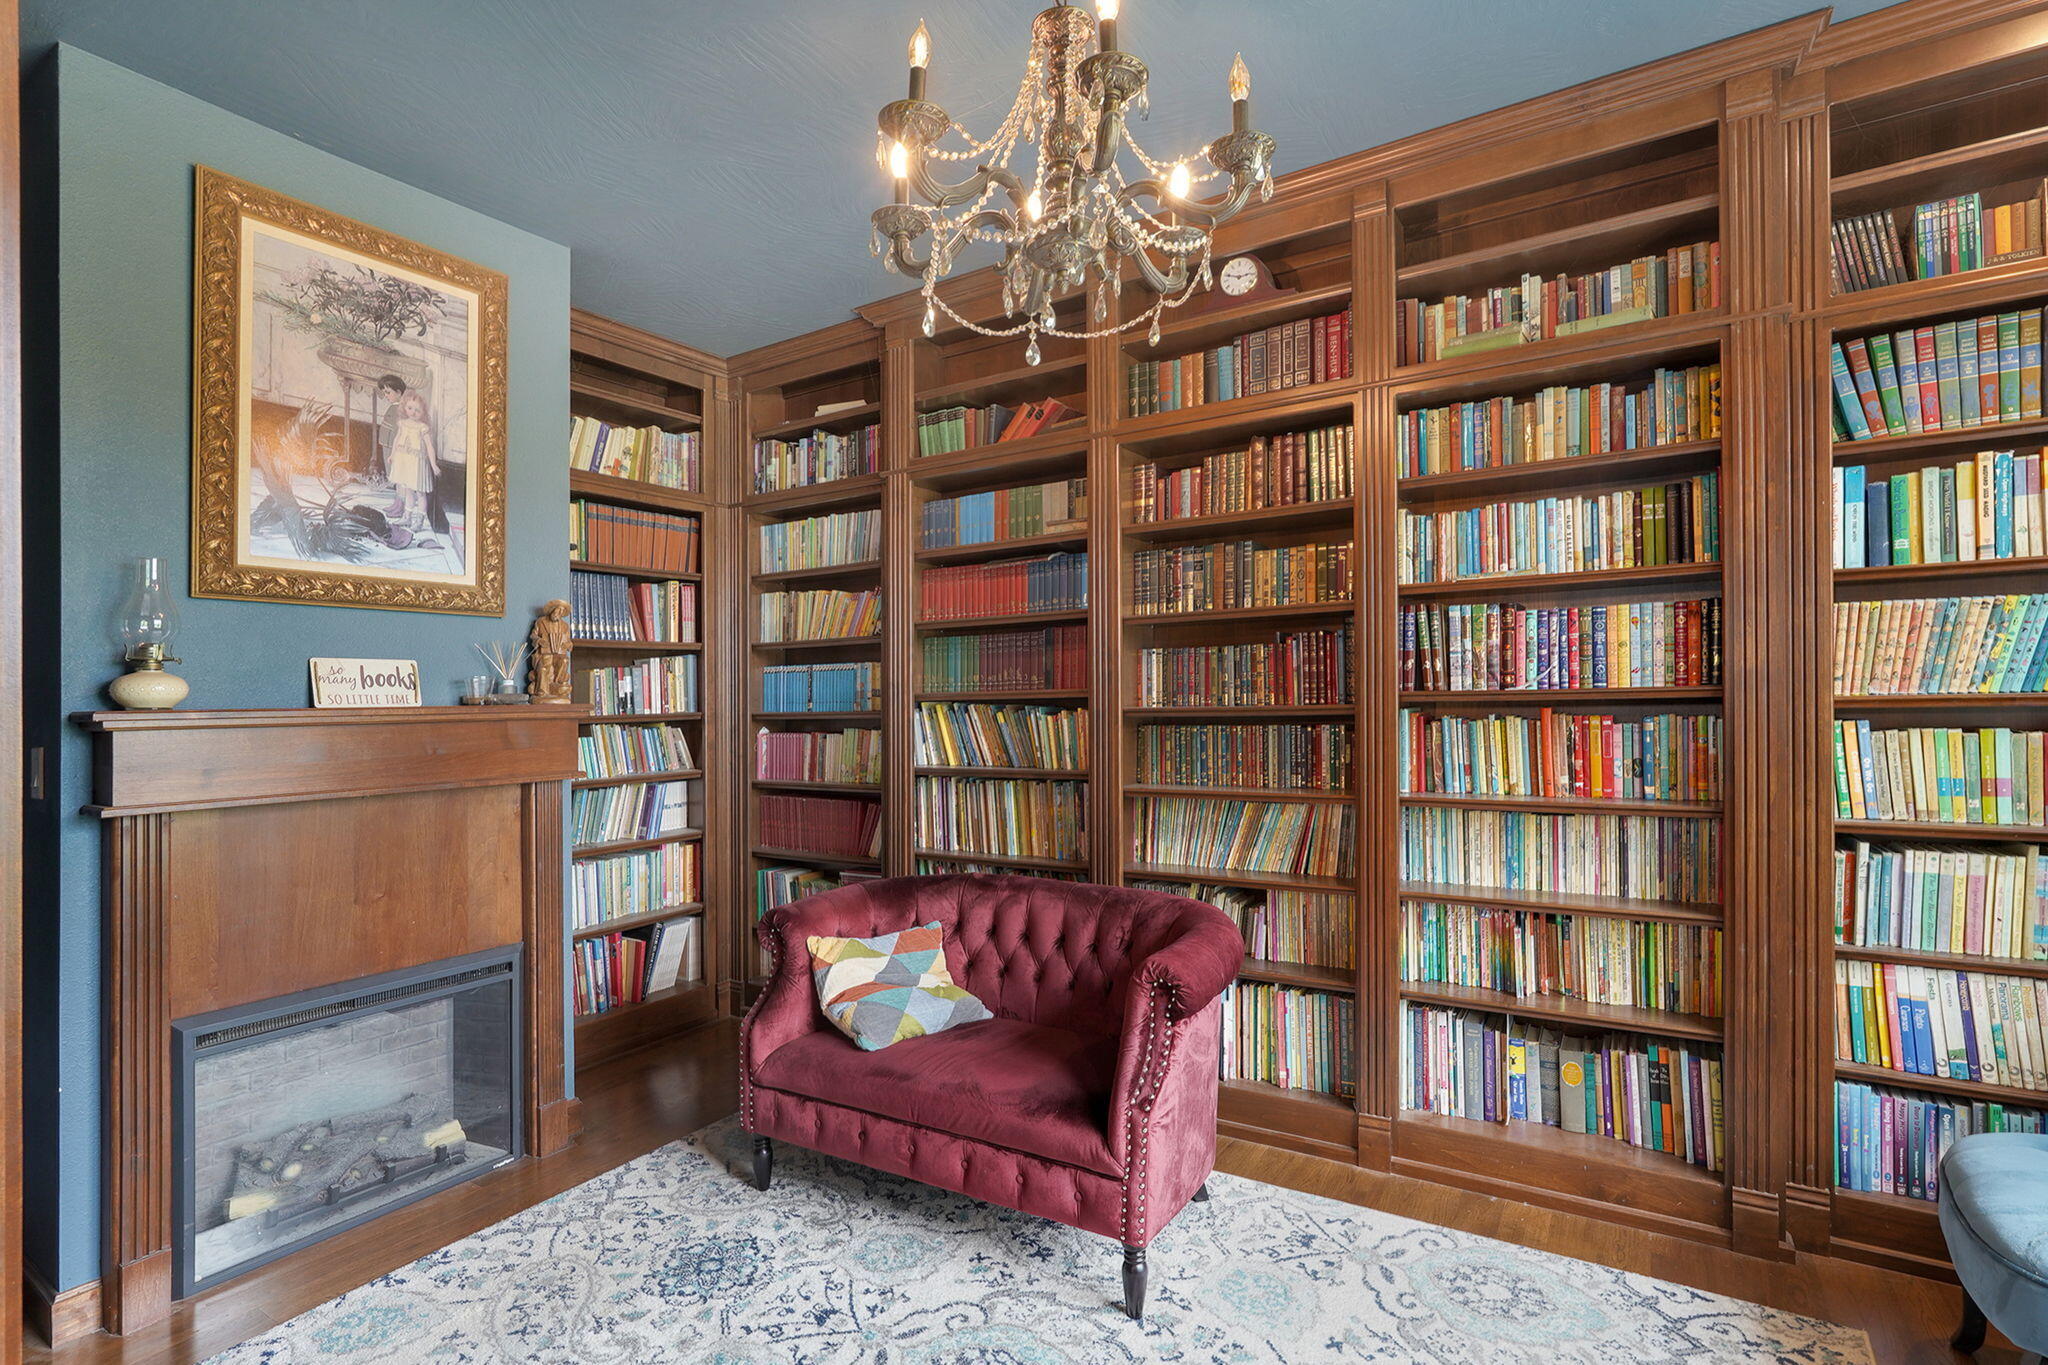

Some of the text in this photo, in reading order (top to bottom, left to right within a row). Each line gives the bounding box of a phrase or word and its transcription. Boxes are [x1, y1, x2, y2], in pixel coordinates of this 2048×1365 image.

[1329, 335, 1338, 375] BEN-HUR
[1943, 479, 1953, 490] The
[1943, 490, 1953, 508] World
[318, 664, 417, 691] many books
[329, 665, 344, 676] so
[327, 694, 410, 705] SO LITTLE TIME
[1863, 757, 1873, 793] On We Go
[1929, 874, 1937, 887] The
[1928, 888, 1936, 902] New
[1998, 982, 2010, 1020] Panorama
[2011, 984, 2024, 1022] Rainbows
[1912, 1106, 1921, 1121] Doors
[1942, 1113, 1952, 1130] Open
